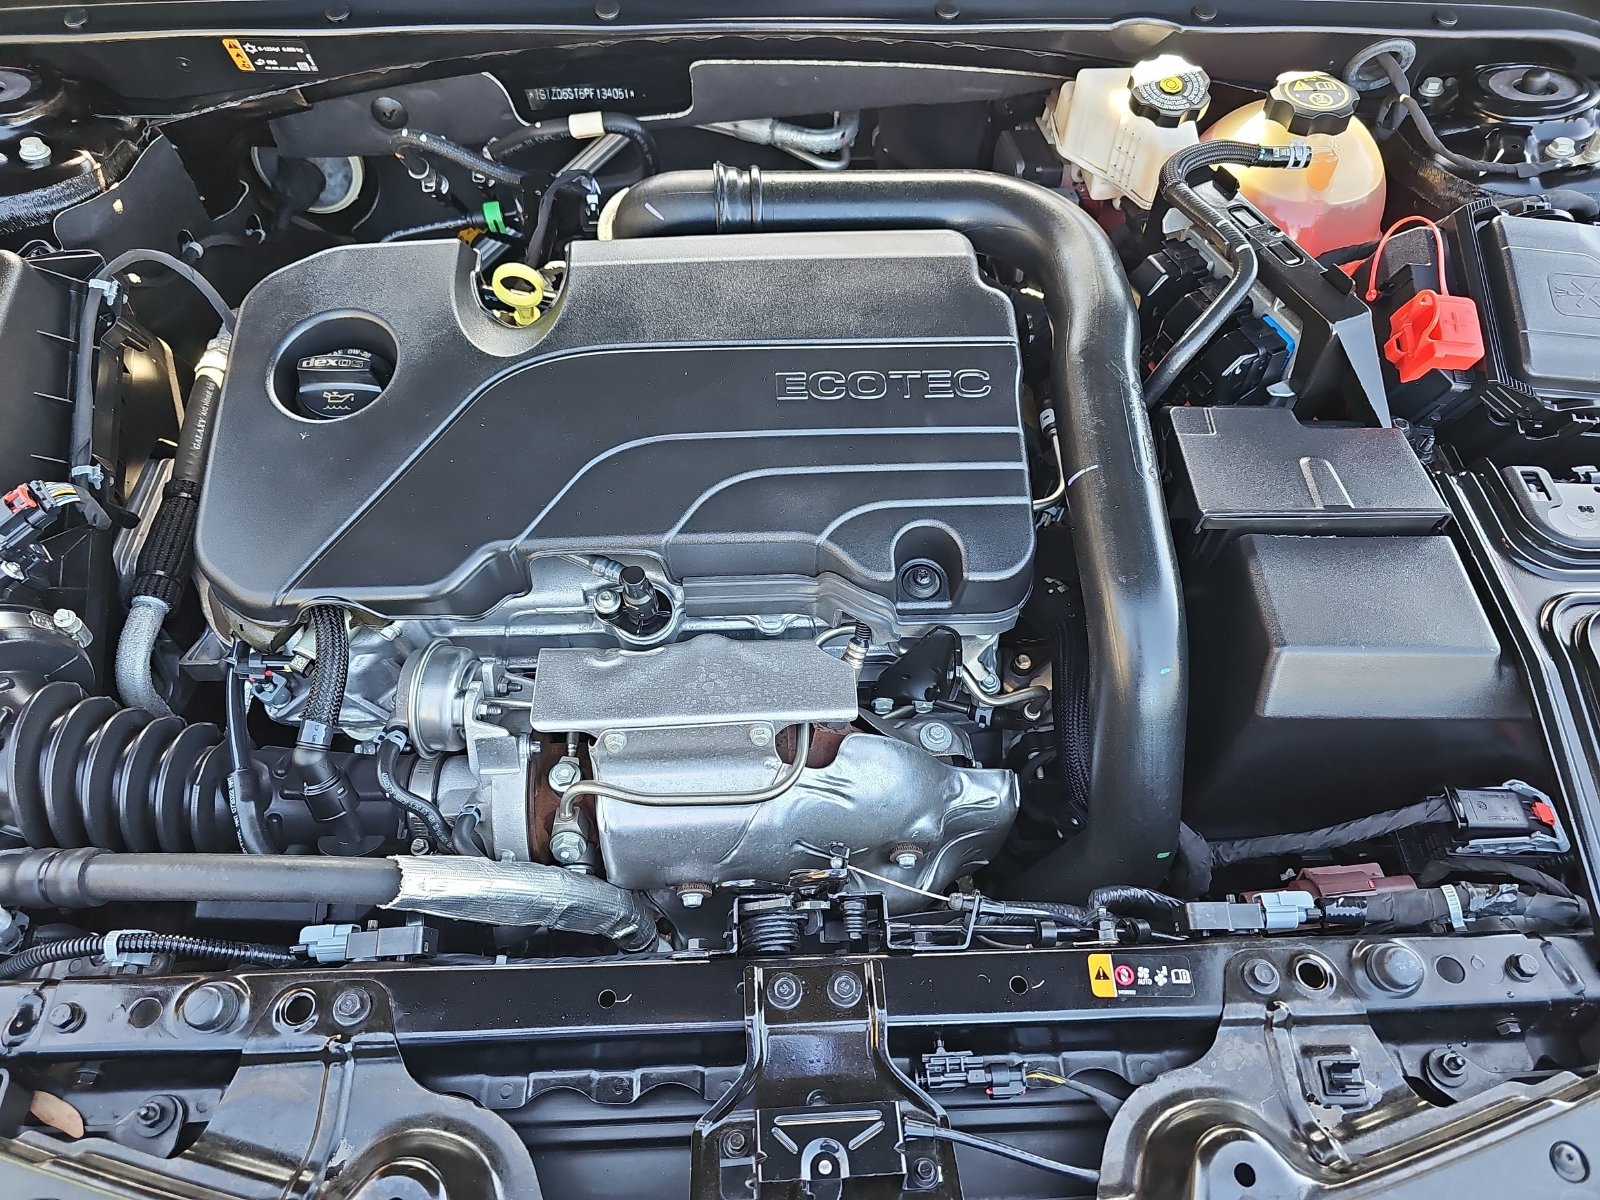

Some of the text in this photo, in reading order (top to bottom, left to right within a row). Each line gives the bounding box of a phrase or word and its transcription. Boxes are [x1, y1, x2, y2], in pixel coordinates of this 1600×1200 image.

[302, 358, 364, 368] dexos
[775, 368, 992, 400] ECOTEC
[193, 417, 207, 450] GALAXY
